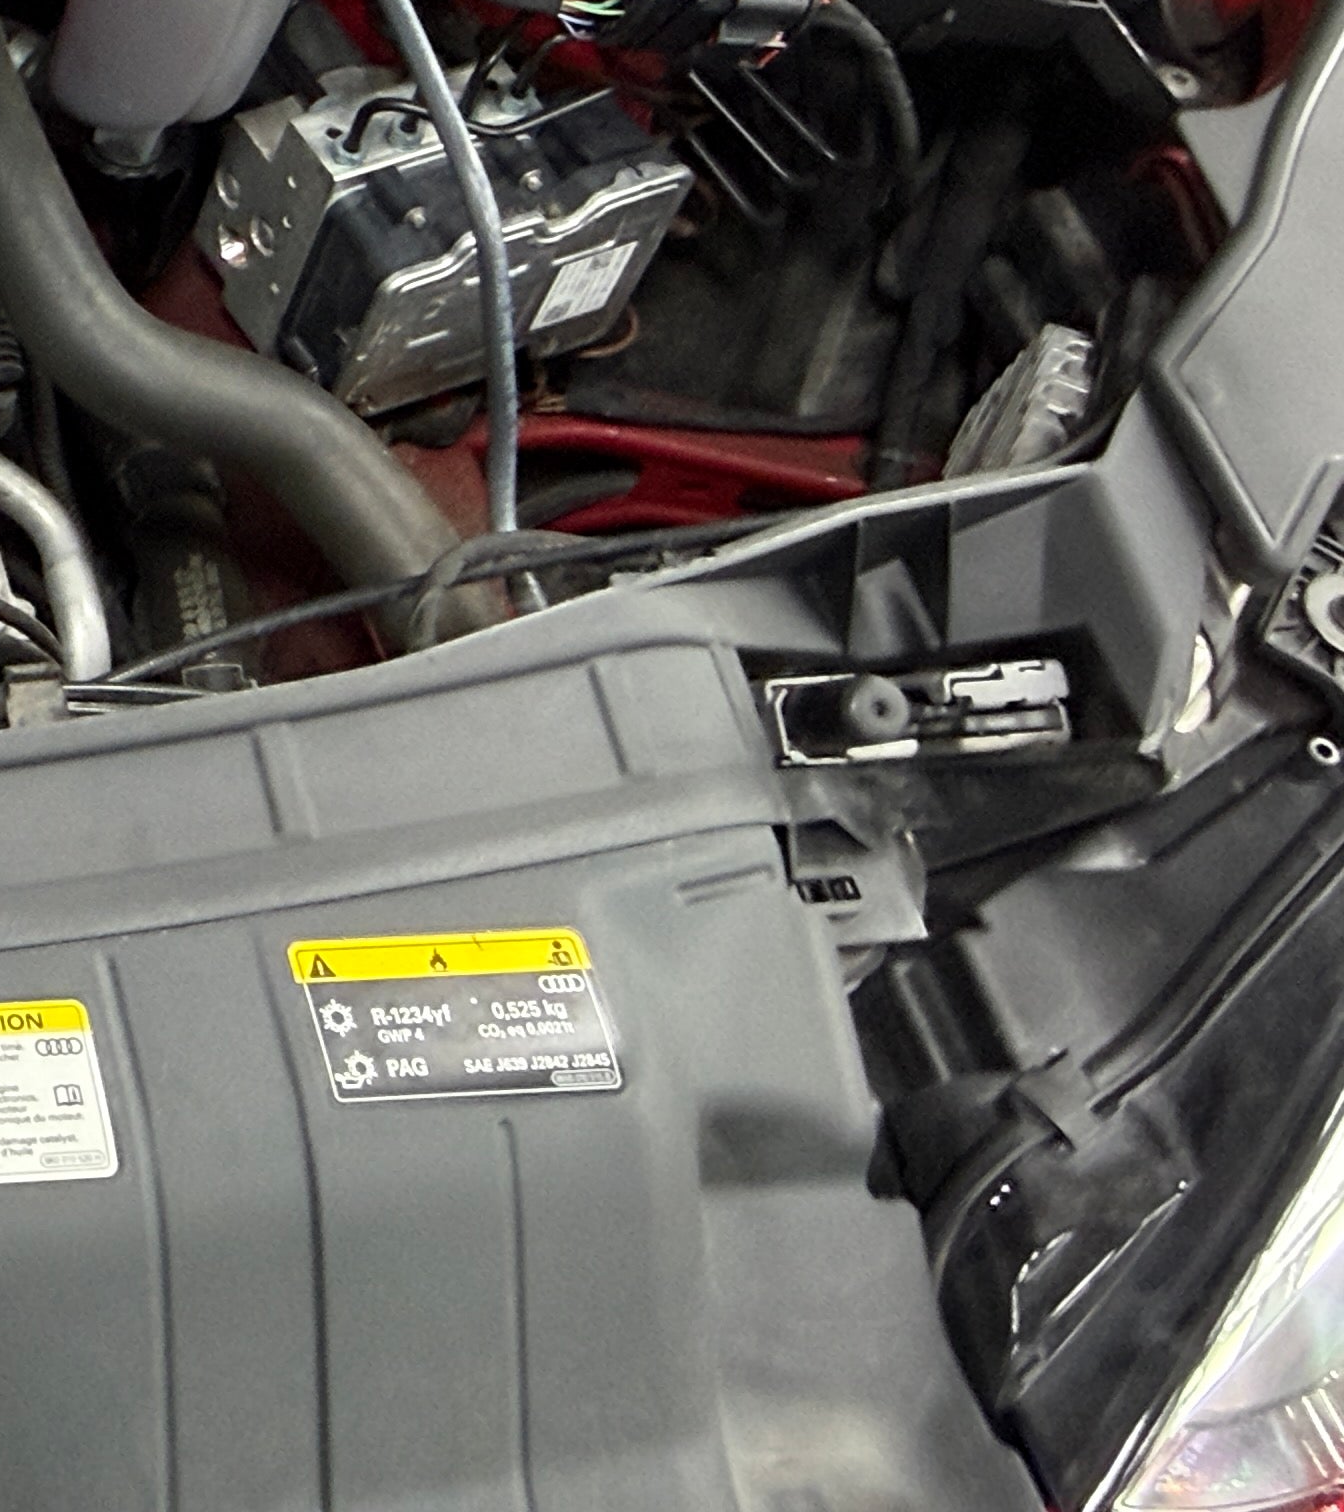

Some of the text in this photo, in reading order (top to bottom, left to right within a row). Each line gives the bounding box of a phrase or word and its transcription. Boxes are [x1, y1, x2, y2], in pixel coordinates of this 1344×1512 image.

[370, 1003, 451, 1026] R-1234yf
[542, 999, 568, 1019] kg
[377, 1028, 412, 1043] GWP
[414, 1027, 425, 1040] 4
[386, 1057, 429, 1077] PAG
[463, 1058, 494, 1074] SAE
[33, 1114, 46, 1122] du
[0, 1136, 37, 1146] damage
